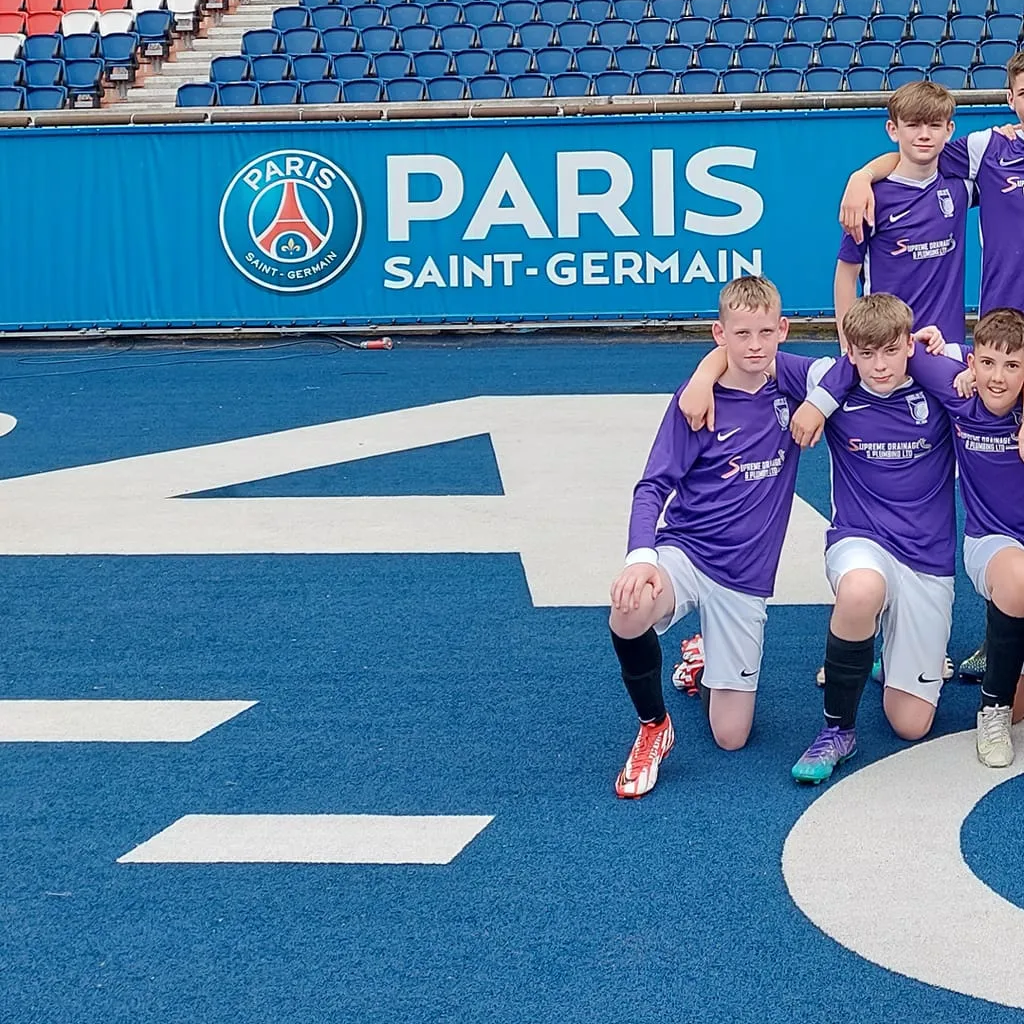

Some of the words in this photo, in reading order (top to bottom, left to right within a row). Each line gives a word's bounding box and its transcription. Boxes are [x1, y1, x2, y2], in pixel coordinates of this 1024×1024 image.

[242, 156, 337, 192] PARIS
[386, 146, 765, 241] PARIS
[384, 249, 762, 289] SAINT-GERMAIN
[848, 438, 886, 451] SUPREME
